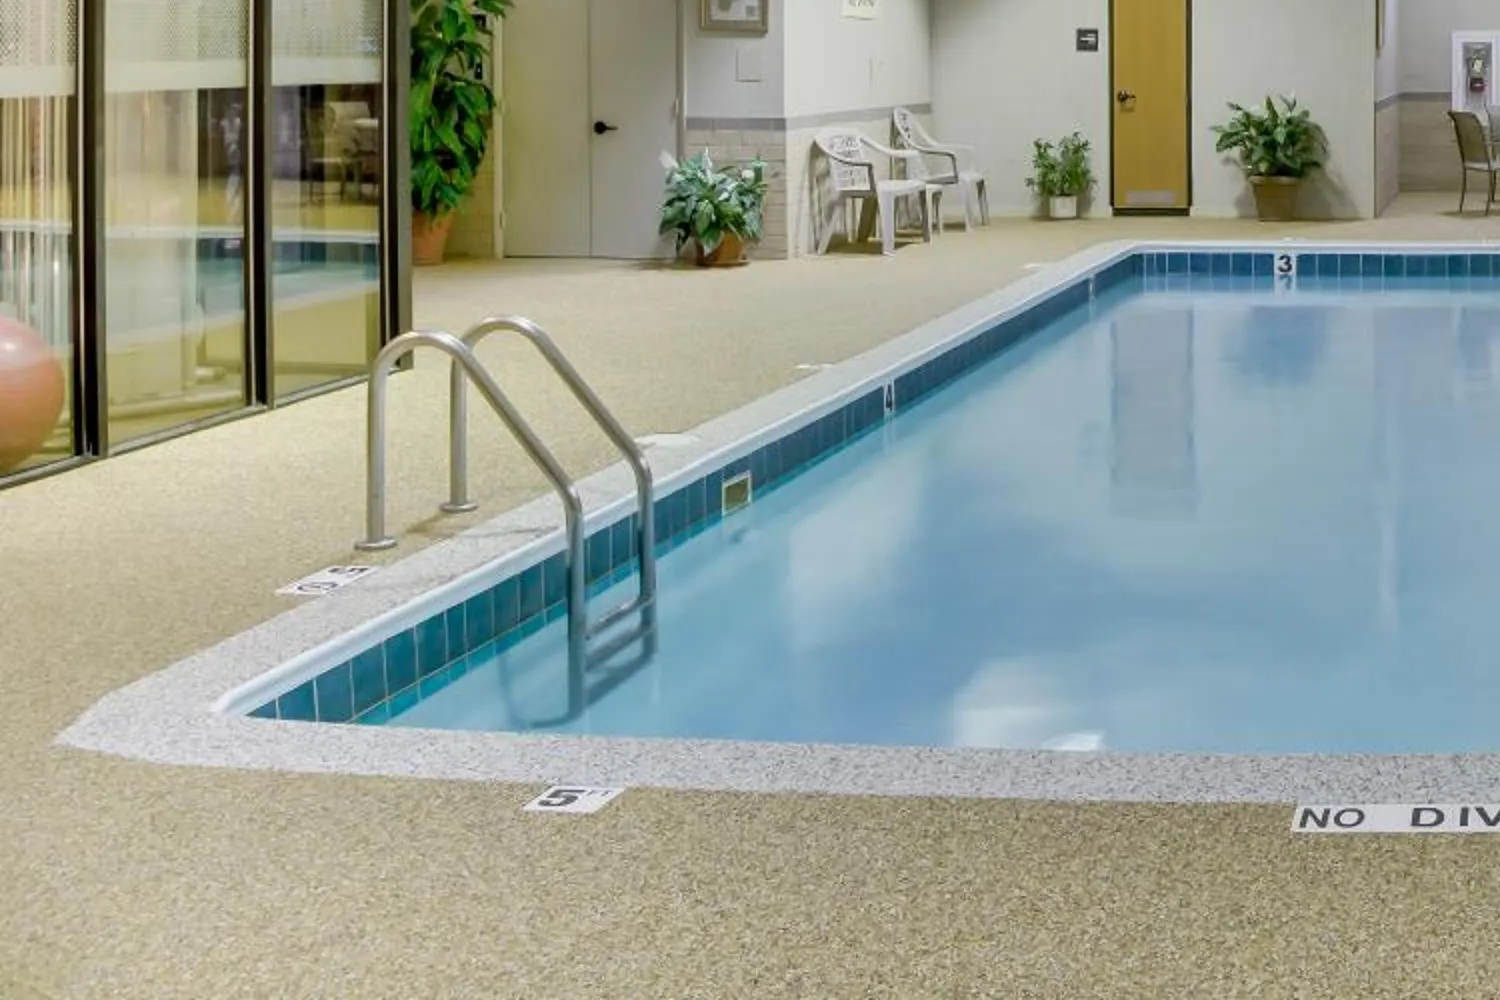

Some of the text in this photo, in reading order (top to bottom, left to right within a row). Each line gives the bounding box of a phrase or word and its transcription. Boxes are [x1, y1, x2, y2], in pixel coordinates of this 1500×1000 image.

[1277, 254, 1293, 273] 3
[537, 789, 586, 806] 5
[1300, 807, 1366, 828] NO
